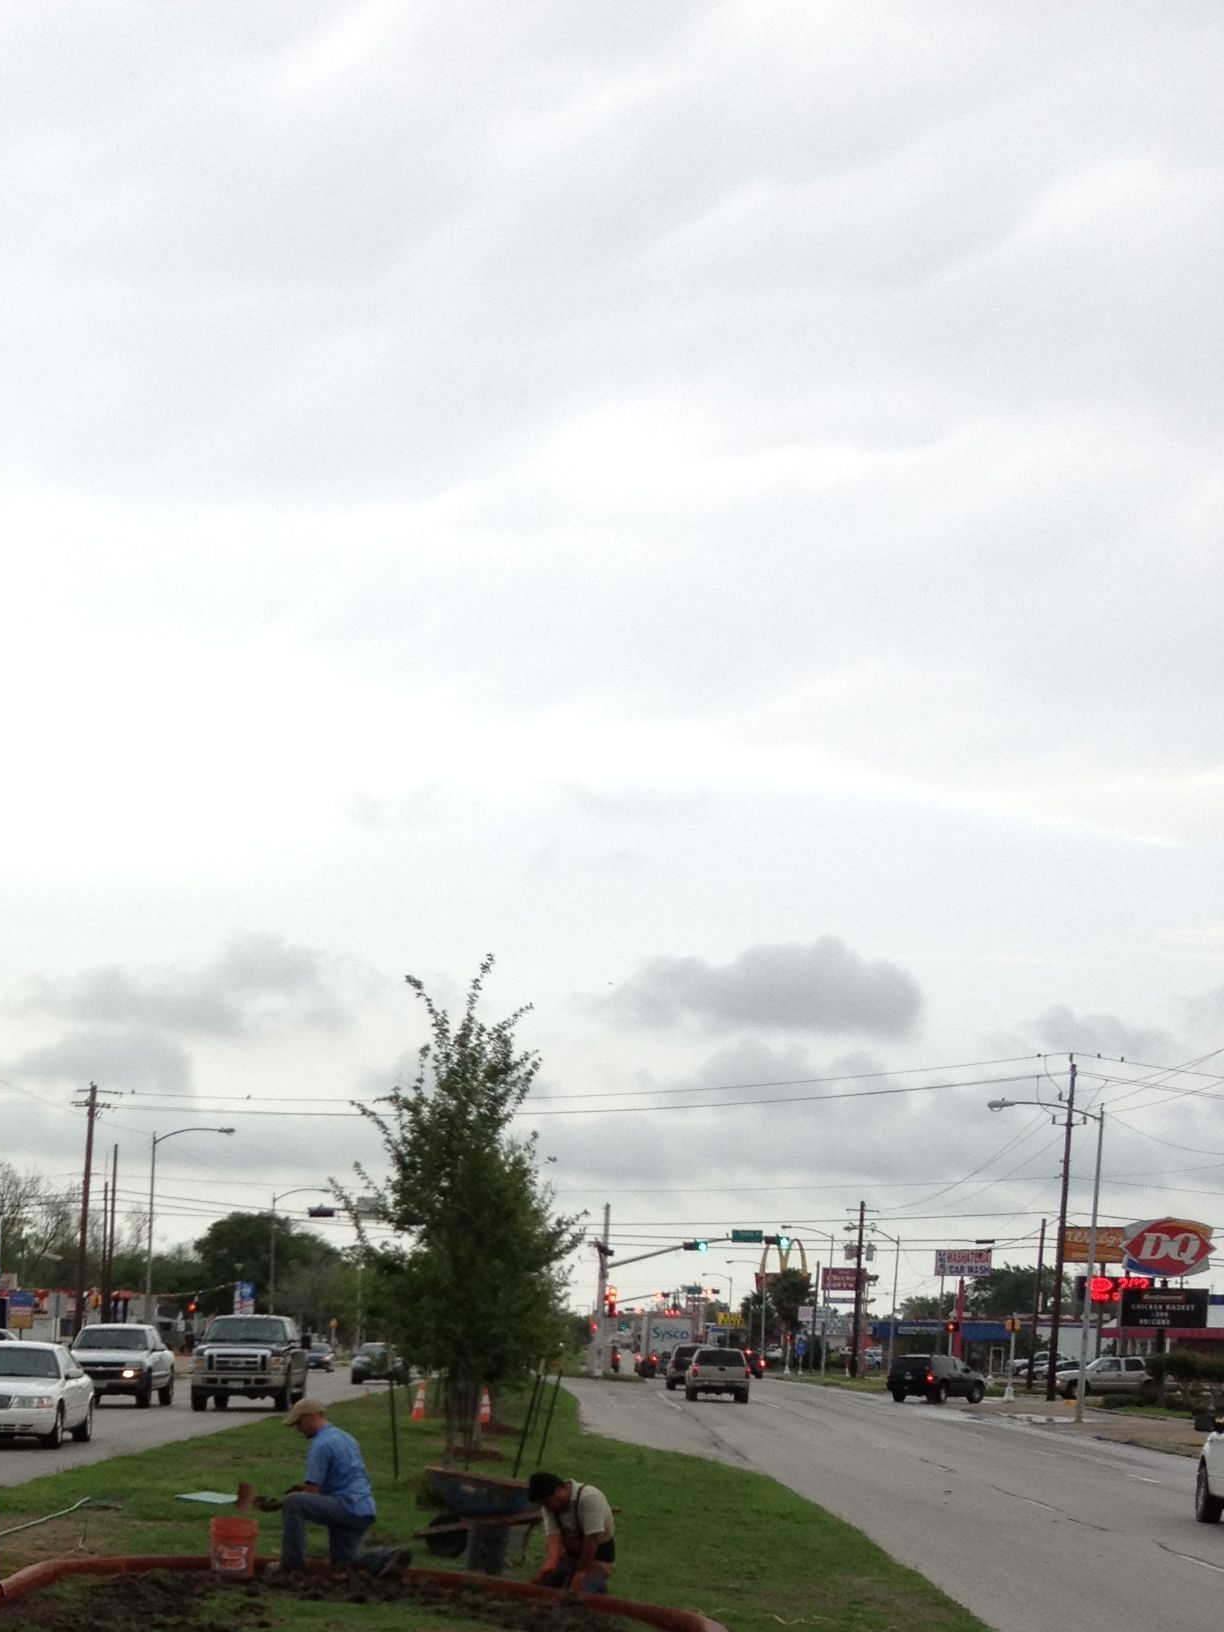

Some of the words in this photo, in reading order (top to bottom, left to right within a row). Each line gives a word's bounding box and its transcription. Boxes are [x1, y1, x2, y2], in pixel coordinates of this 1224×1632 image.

[1137, 1232, 1201, 1265] DQ
[948, 1265, 965, 1275] CAR
[967, 1265, 989, 1275] WASH
[652, 1327, 689, 1342] Sysco
